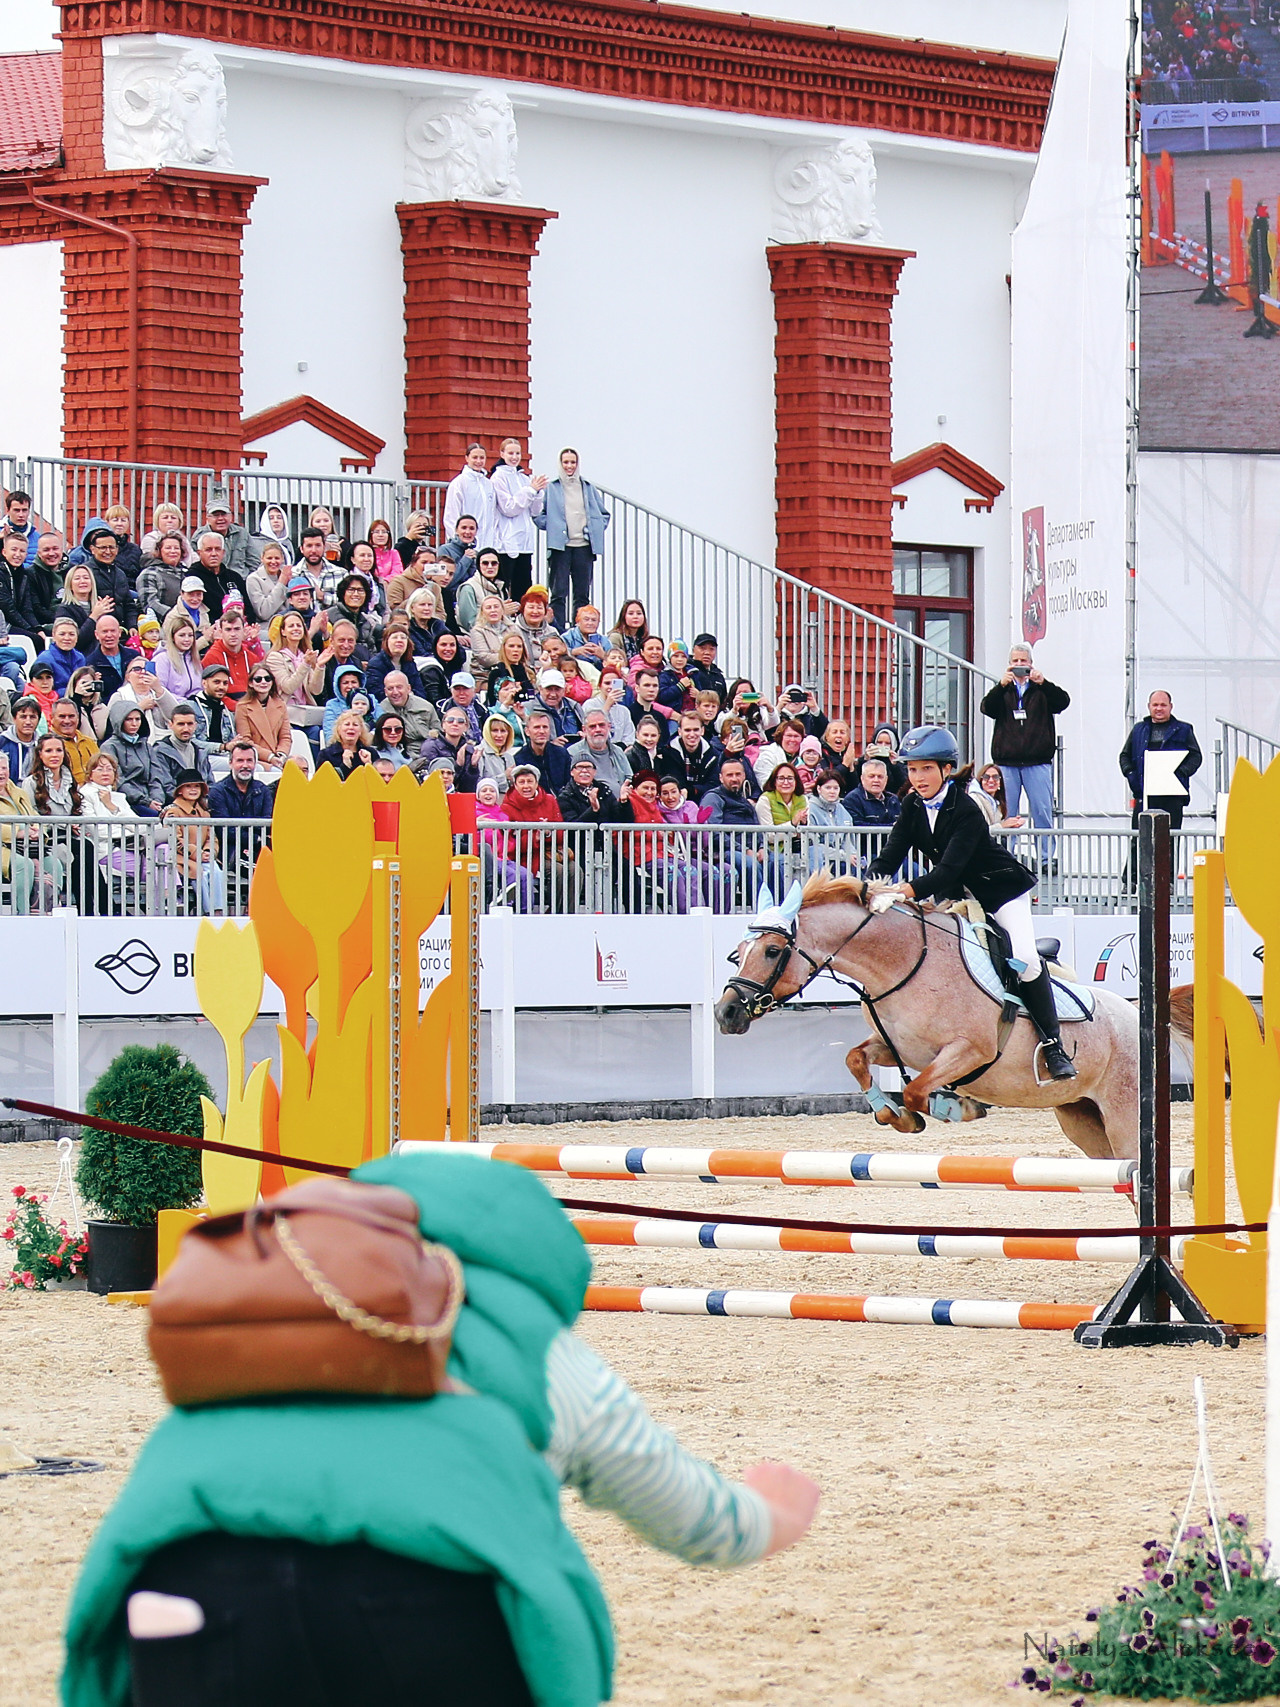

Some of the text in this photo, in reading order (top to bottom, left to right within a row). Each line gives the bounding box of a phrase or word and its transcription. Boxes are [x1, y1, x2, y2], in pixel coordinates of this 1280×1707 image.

[1231, 110, 1260, 118] BITRIVER
[1047, 520, 1095, 550] Департамент
[1048, 558, 1077, 587] культуры
[1048, 586, 1108, 620] города Москвы
